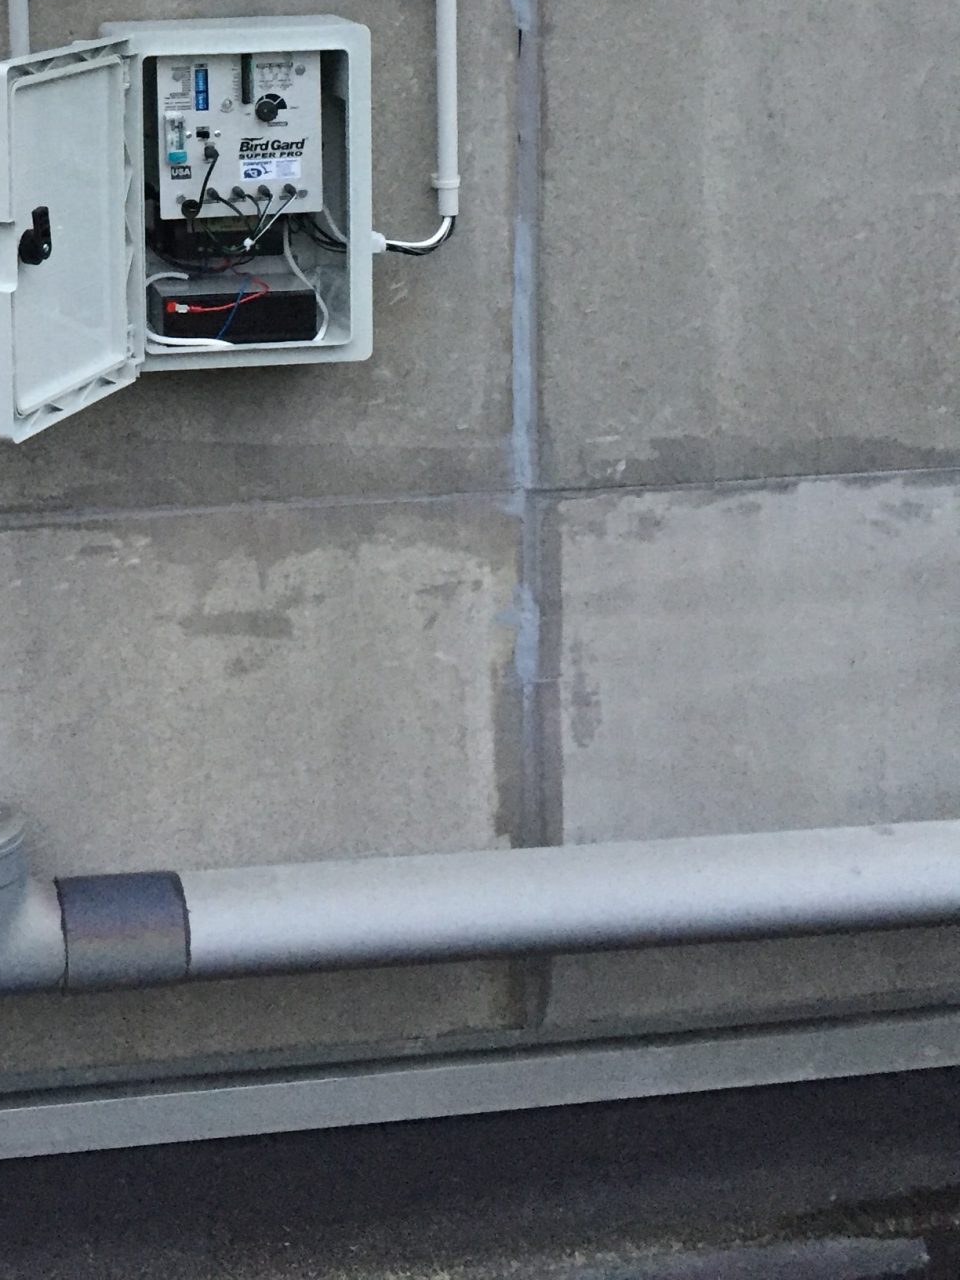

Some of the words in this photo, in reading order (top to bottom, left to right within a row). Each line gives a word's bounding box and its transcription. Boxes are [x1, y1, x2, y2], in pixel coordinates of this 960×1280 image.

[240, 138, 270, 152] Bird
[271, 138, 305, 150] Gard
[239, 152, 276, 160] SUPER
[172, 168, 190, 176] USA
